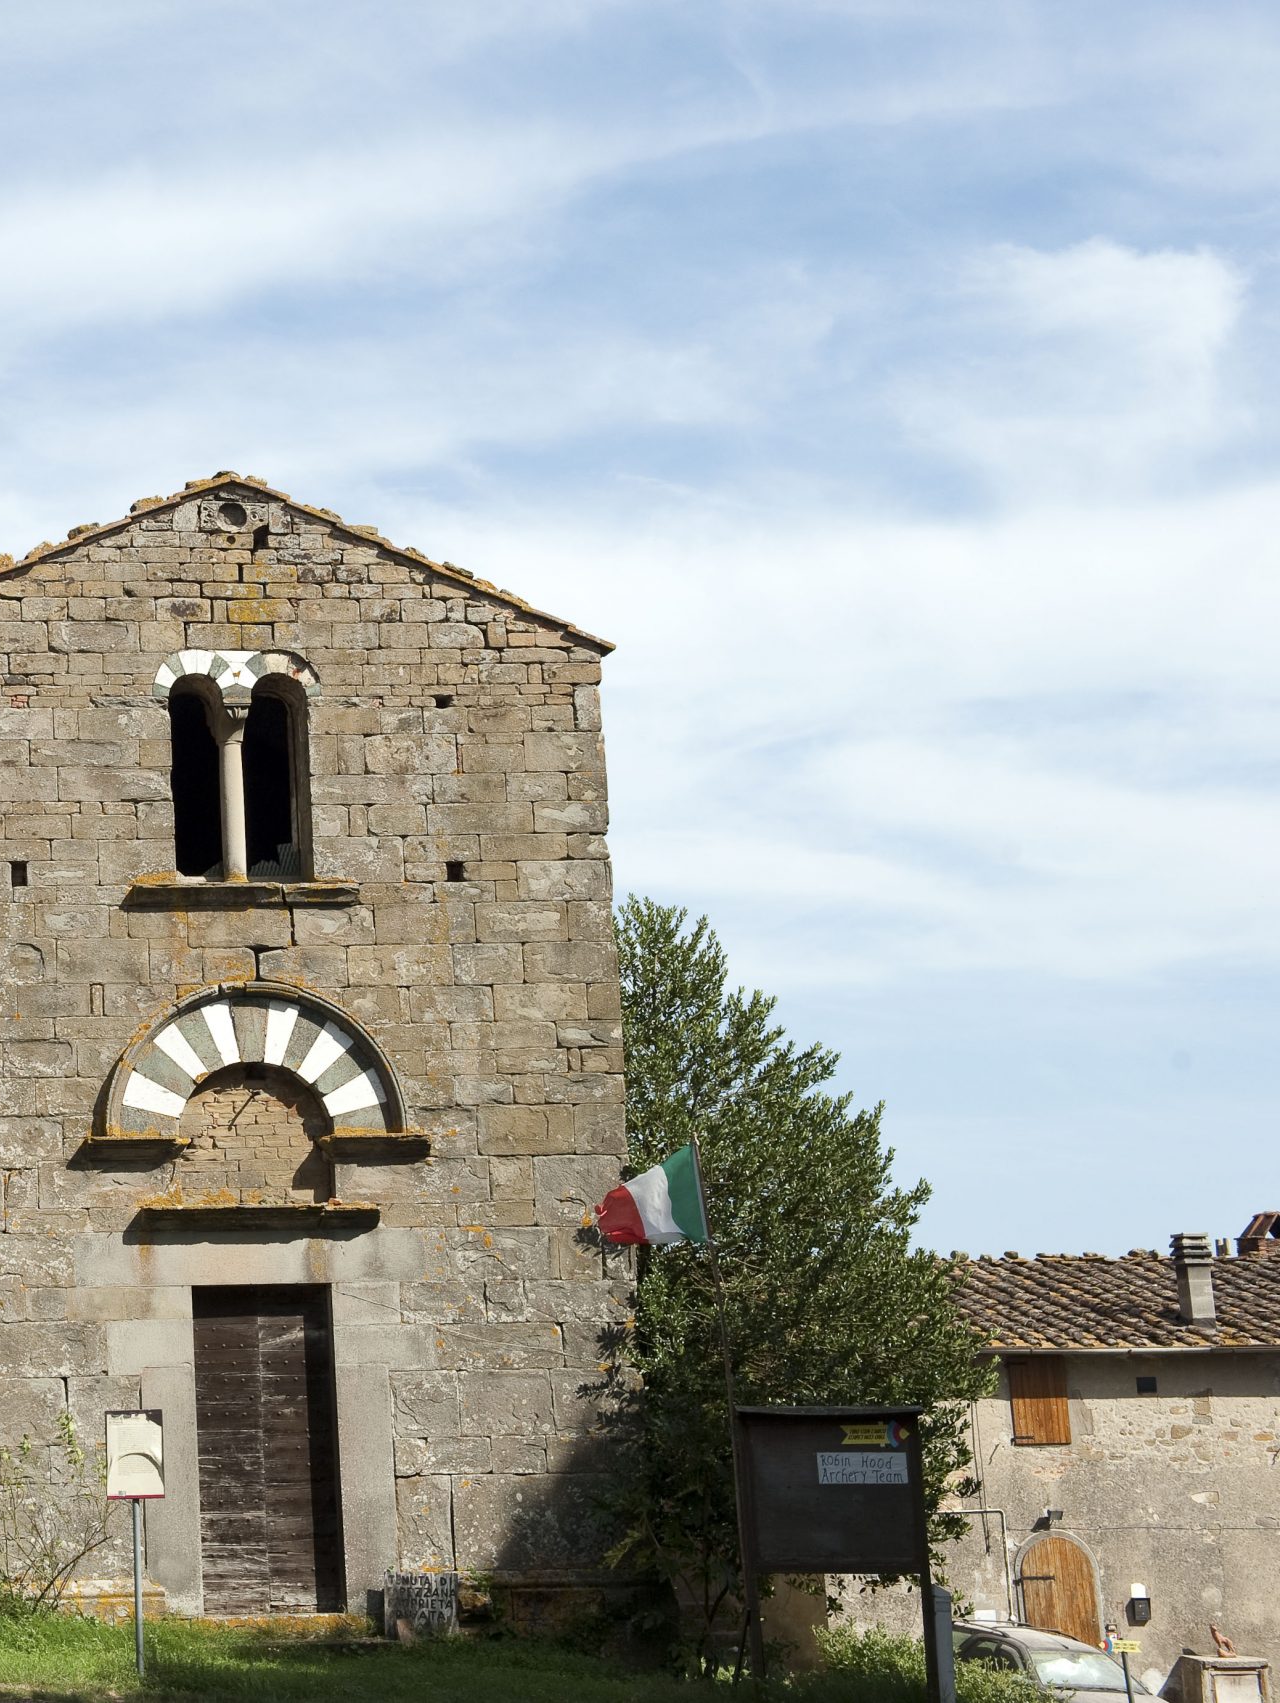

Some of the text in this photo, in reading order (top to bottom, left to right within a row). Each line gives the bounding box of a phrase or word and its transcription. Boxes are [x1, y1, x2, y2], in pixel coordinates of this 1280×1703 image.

[821, 1468, 904, 1484] Archery Team
[388, 1598, 454, 1610] POPRIETA
[390, 1609, 446, 1621] RIVATA
